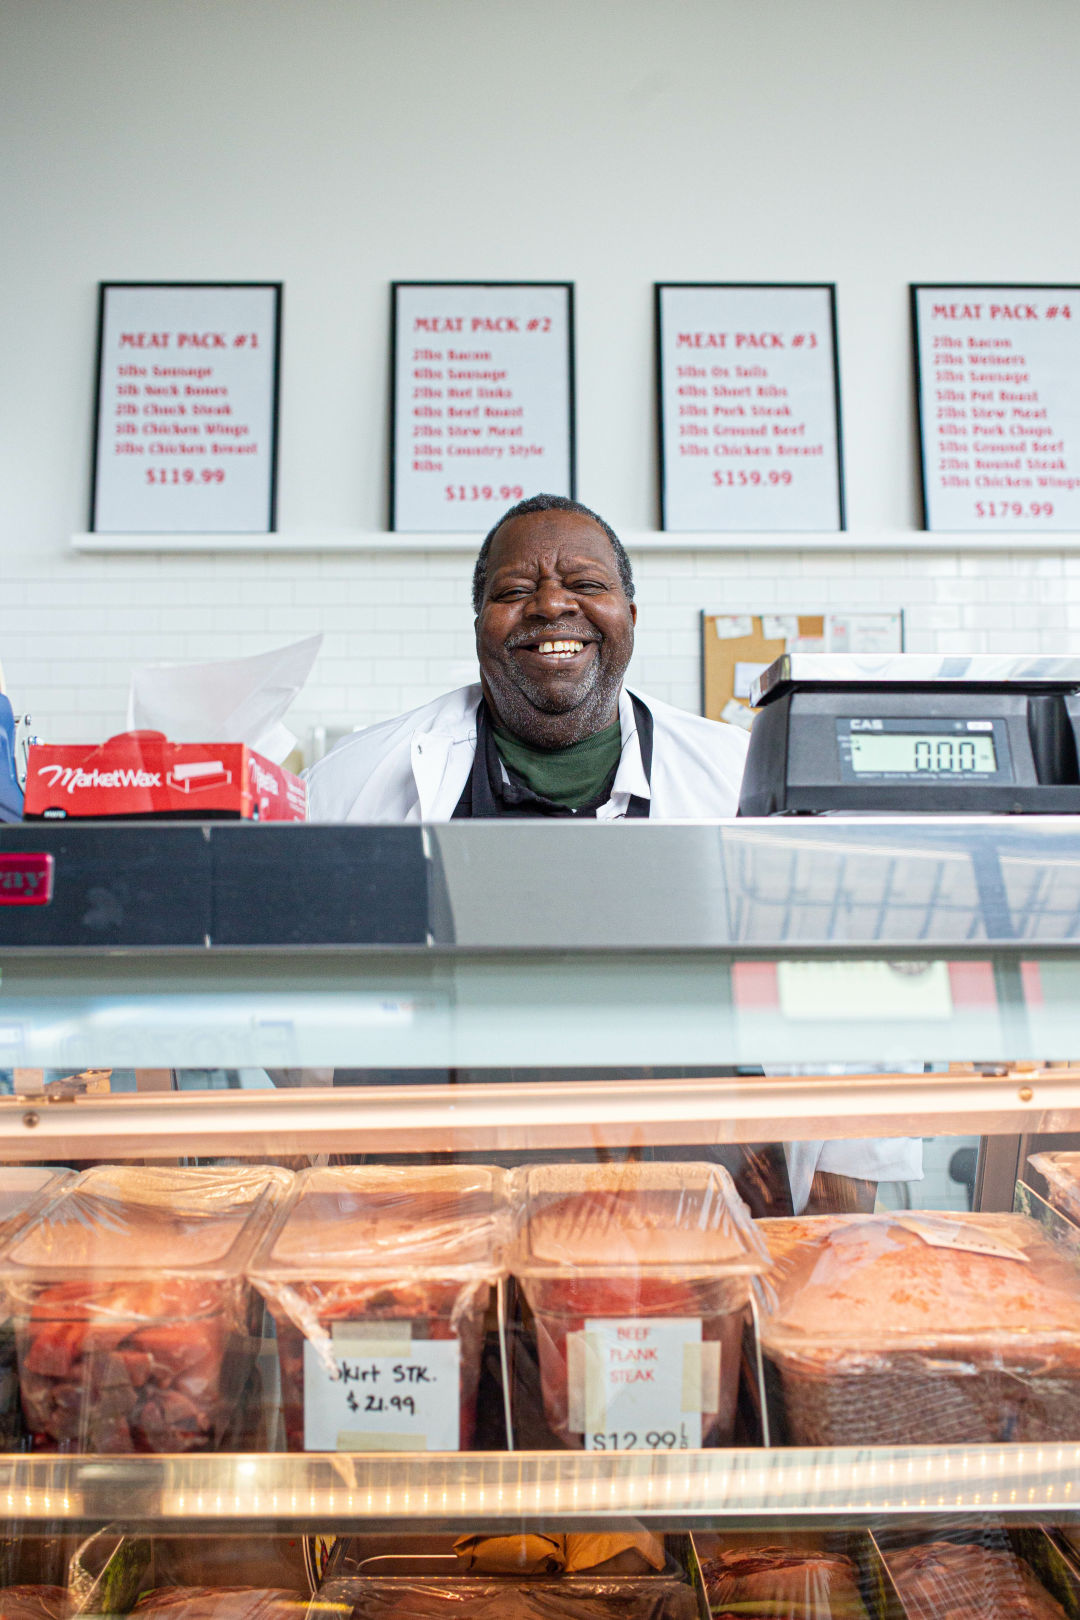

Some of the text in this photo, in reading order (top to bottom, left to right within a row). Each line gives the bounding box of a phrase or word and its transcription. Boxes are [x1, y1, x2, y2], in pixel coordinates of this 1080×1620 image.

[932, 304, 1072, 320] MEAT PACK #4
[413, 317, 552, 333] MEAT PACK #2
[119, 332, 259, 350] MEAT PACK #1
[676, 333, 818, 349] MEAT PACK #3
[967, 337, 1012, 348] Bacon
[447, 349, 492, 361] Bacon
[152, 366, 213, 380] Sausage
[448, 370, 507, 382] Sausage
[970, 372, 1029, 385] Sausage
[712, 386, 751, 397] Short
[756, 385, 788, 397] Ribs
[999, 392, 1038, 402] Roast
[143, 404, 187, 415] Chuck
[192, 404, 232, 416] Steak
[448, 407, 479, 418] Beef
[484, 407, 523, 417] Roast
[712, 406, 746, 416] Pork
[752, 405, 792, 416] Steak
[971, 409, 1005, 418] Stew
[1012, 408, 1047, 419] Meat
[143, 424, 199, 435] Chicken
[448, 426, 482, 436] Stew
[488, 426, 523, 437] Meat
[713, 426, 767, 436] Ground
[772, 424, 805, 436] Beef
[973, 425, 1004, 436] Pork
[1009, 426, 1053, 438] Chops
[149, 443, 206, 454] Chicken
[211, 443, 258, 456] Breast
[713, 444, 771, 456] Chicken
[776, 444, 824, 456] Breast
[973, 443, 1026, 452] Ground
[1032, 440, 1064, 452] Beef
[412, 460, 443, 472] Ribs
[974, 459, 1021, 469] Round
[1026, 459, 1066, 470] Steak
[146, 468, 226, 485] $119.99
[712, 470, 792, 487] $159.99
[974, 477, 1032, 487] Chicken
[445, 485, 524, 502] $139.99
[974, 501, 1054, 518] $179.99
[850, 719, 883, 730] CAS
[38, 765, 162, 794] MarketWax
[617, 1327, 651, 1341] BEEF
[610, 1347, 658, 1362] FLANK
[393, 1365, 437, 1383] STK.
[610, 1368, 655, 1383] STEAK
[346, 1390, 414, 1416] $21.99
